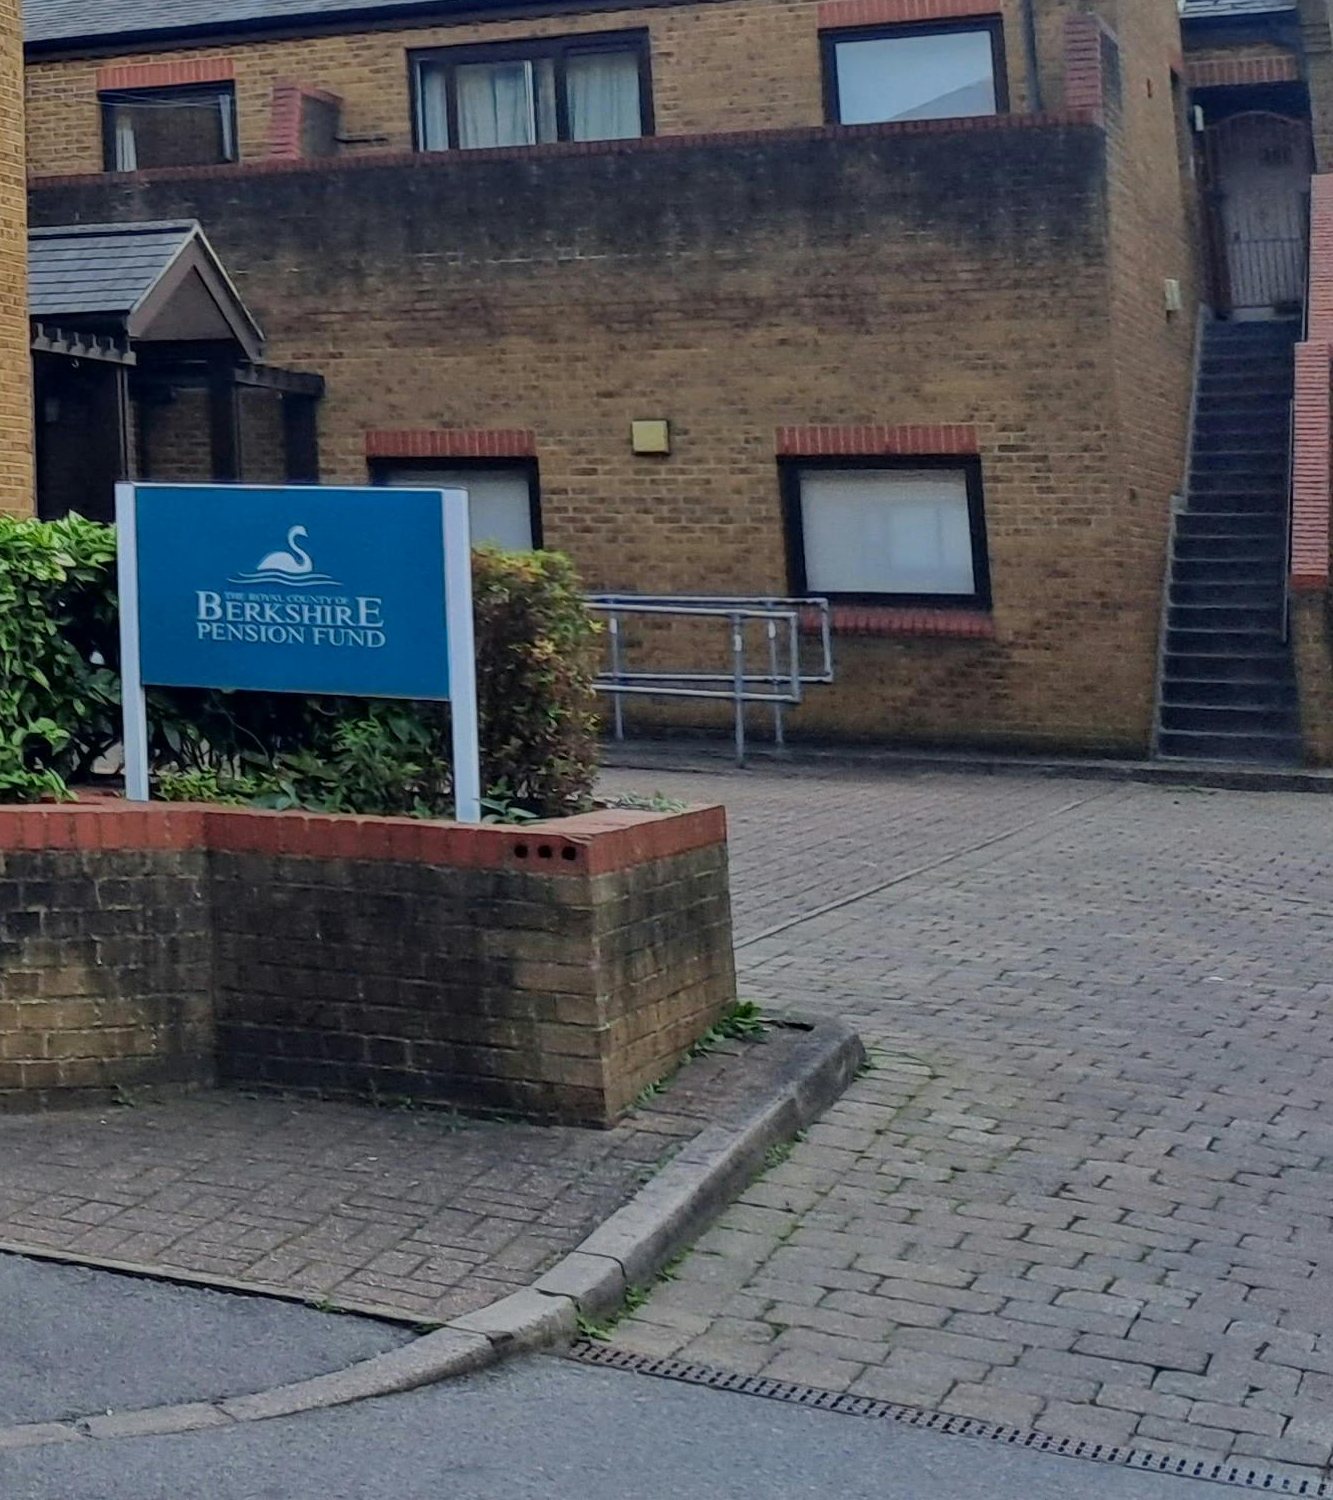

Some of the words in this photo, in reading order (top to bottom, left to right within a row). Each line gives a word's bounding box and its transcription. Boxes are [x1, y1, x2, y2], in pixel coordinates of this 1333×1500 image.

[195, 590, 385, 628] BERKSHIRE
[224, 591, 244, 600] THE
[248, 592, 284, 603] ROYAL
[285, 594, 332, 605] COUNTY
[334, 595, 349, 605] OF
[196, 621, 305, 645] PENSION
[312, 626, 387, 649] FUND
